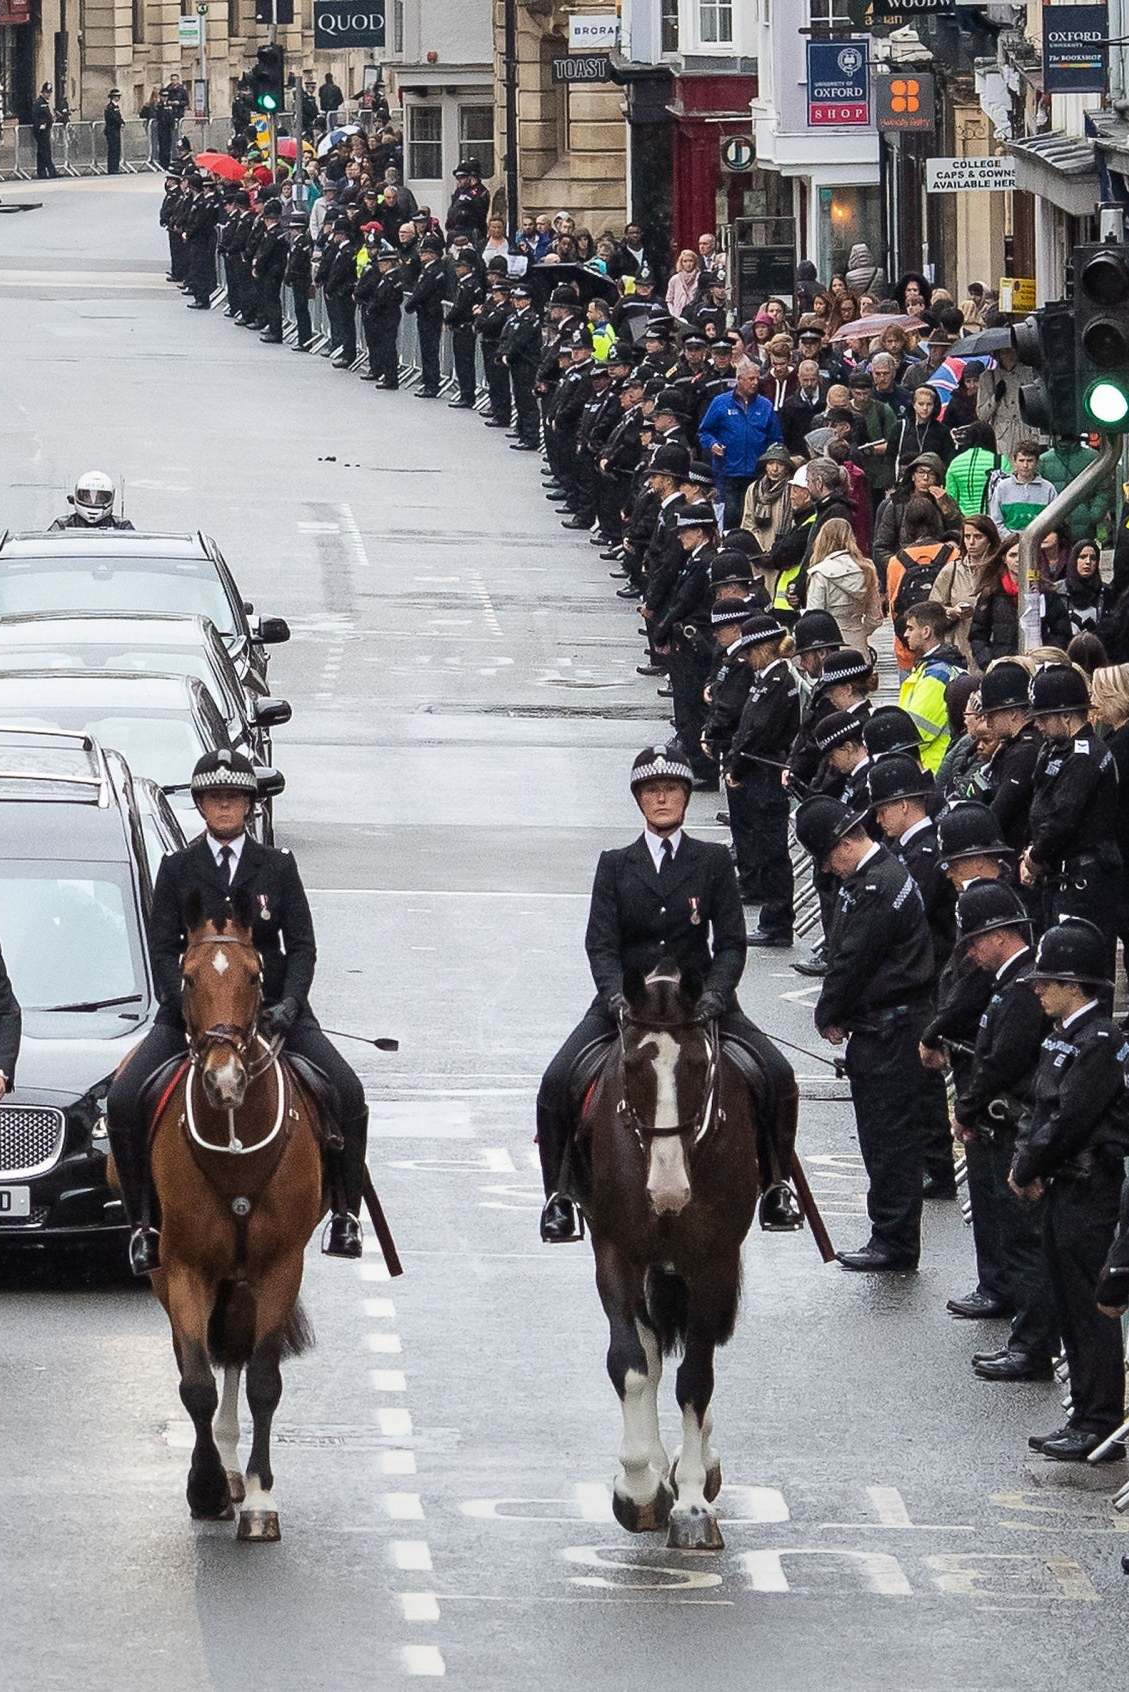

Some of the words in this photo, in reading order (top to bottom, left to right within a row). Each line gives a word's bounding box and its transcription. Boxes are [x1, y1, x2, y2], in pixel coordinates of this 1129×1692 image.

[318, 13, 385, 36] QUOD
[574, 26, 614, 35] BRORA
[1048, 31, 1102, 41] OXFORD
[553, 58, 608, 79] TOAST
[814, 87, 863, 98] OXFORD
[814, 109, 863, 119] SHOP
[953, 159, 1001, 169] COLLEGE
[936, 170, 964, 179] CAPS
[968, 170, 975, 178] &
[933, 180, 991, 189] AVAILABLE
[994, 179, 1016, 188] HER
